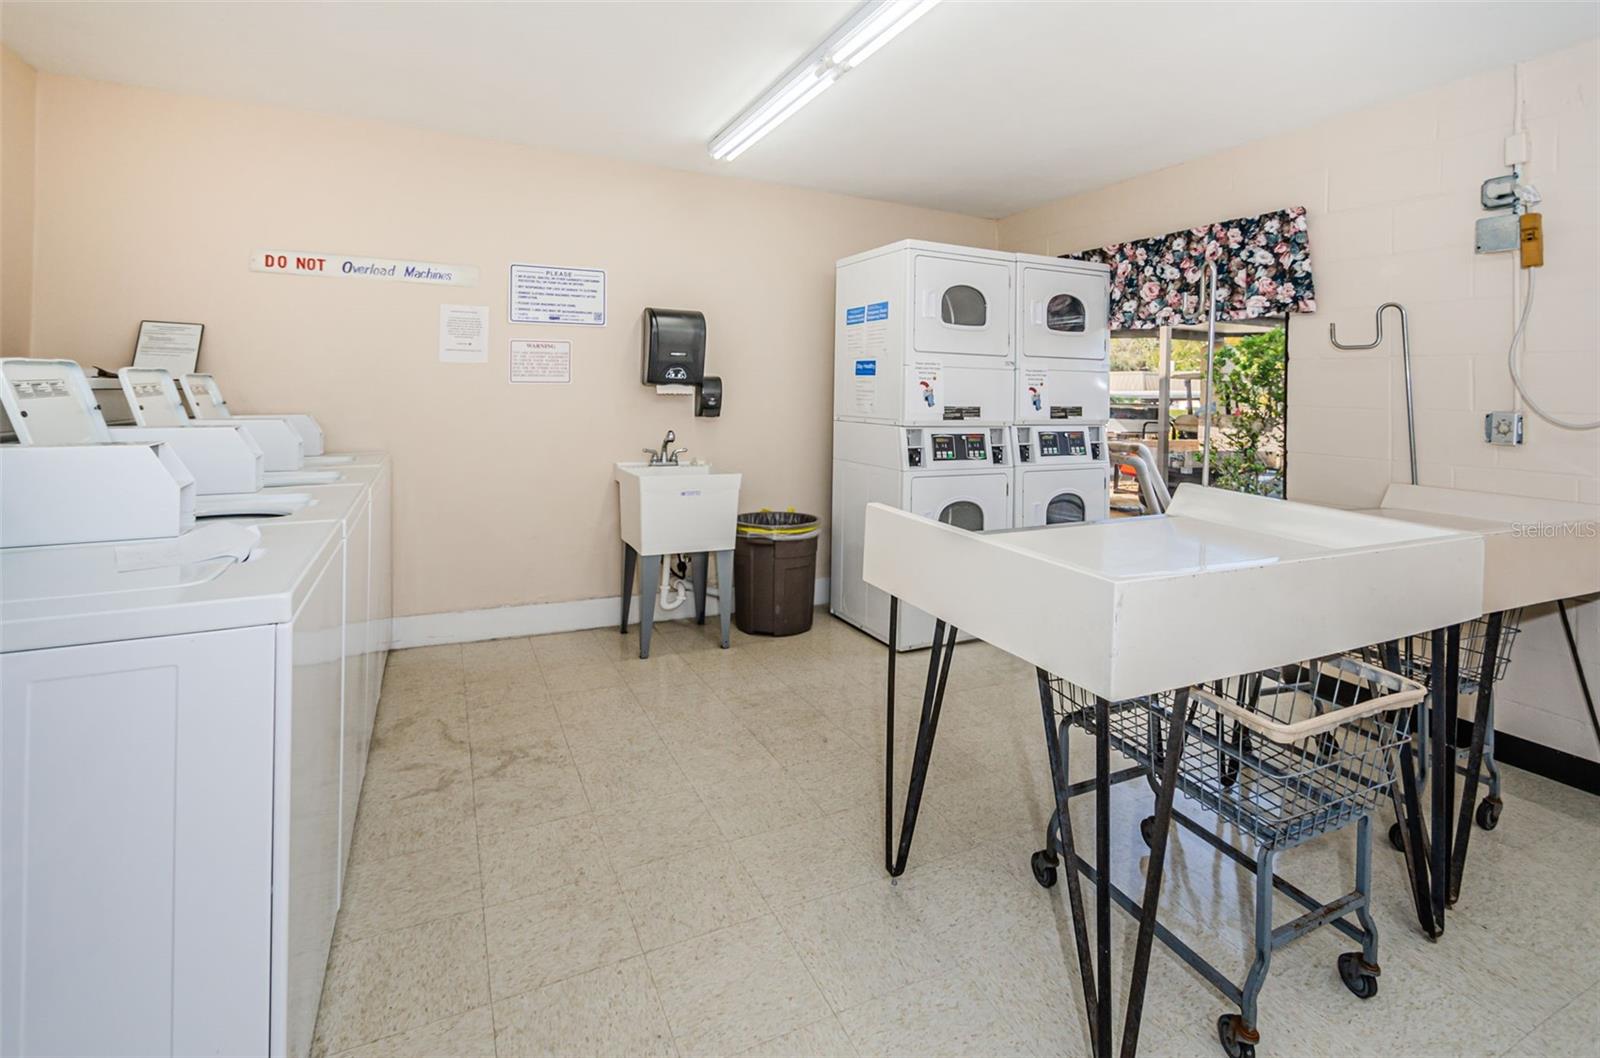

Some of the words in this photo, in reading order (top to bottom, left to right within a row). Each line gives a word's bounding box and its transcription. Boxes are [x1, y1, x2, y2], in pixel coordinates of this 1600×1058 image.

[265, 254, 287, 268] DO
[296, 257, 326, 271] NOT
[342, 260, 396, 276] Overload
[404, 266, 452, 280] Machines
